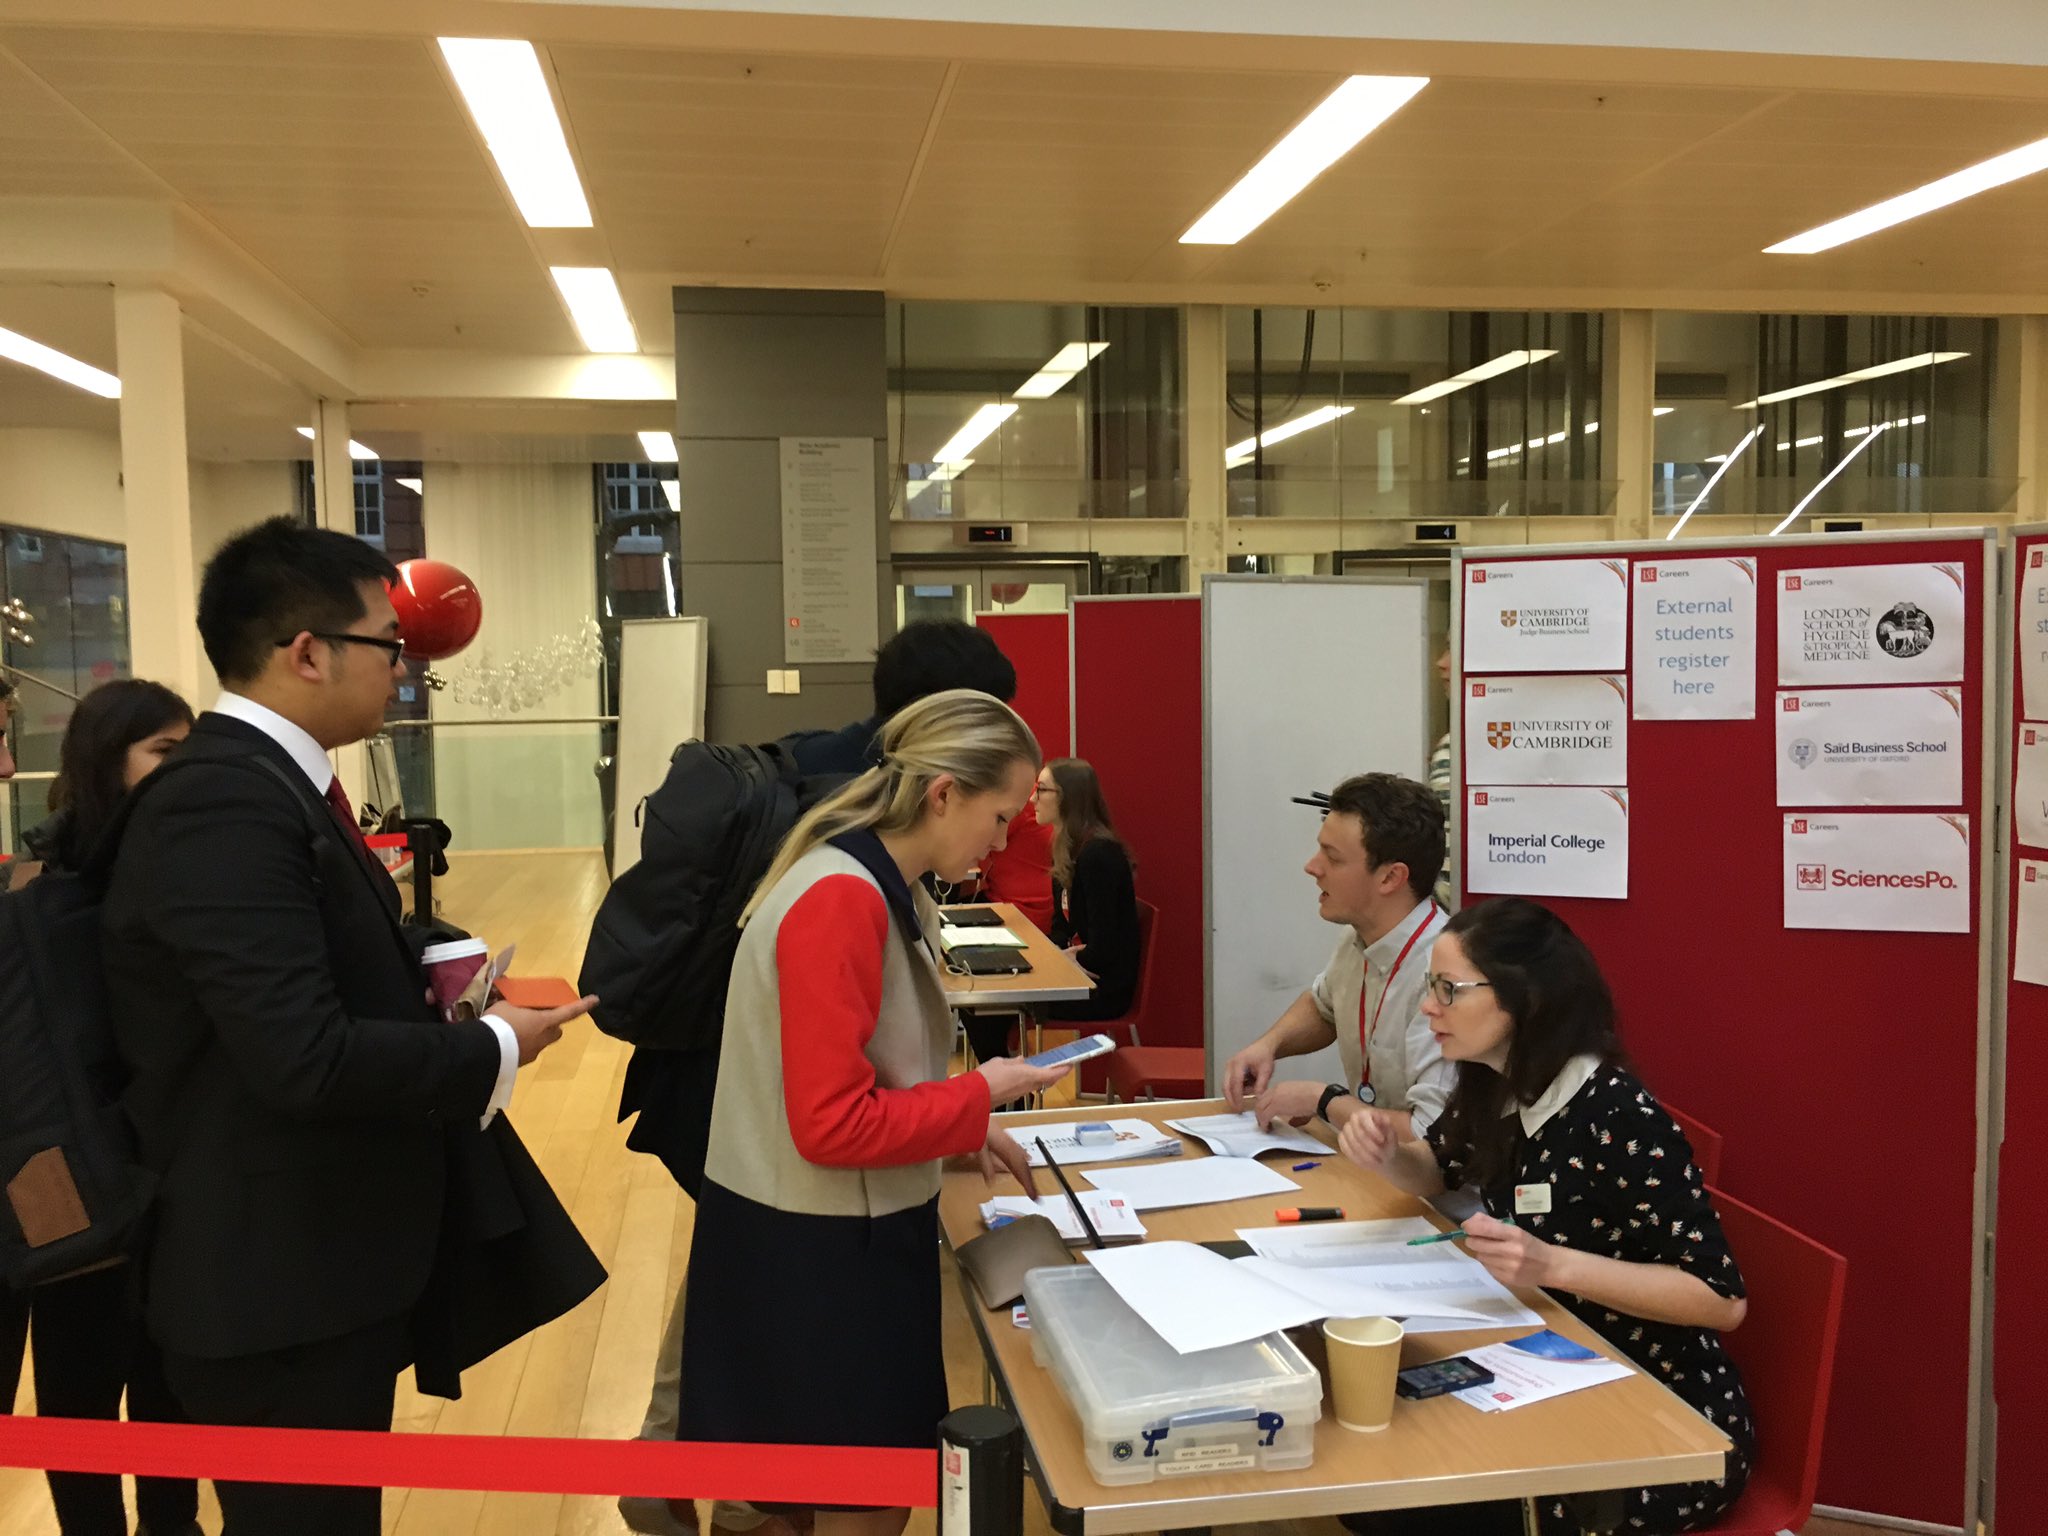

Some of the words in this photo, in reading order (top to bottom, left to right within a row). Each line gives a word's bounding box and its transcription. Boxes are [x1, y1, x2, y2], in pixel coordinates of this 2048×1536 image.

[1443, 526, 1450, 539] 4
[1473, 571, 1486, 583] LSE
[1487, 571, 1514, 580] Careers
[1642, 567, 1656, 582] LSE
[1659, 570, 1690, 579] Careers
[1786, 576, 1800, 590] LSE
[1803, 578, 1833, 587] Careers
[1656, 596, 1734, 615] External
[1519, 607, 1575, 618] UNIVERSITY
[1576, 607, 1590, 616] OF
[1803, 607, 1871, 620] LONDON
[1519, 616, 1590, 628] CAMBRIDGE
[1803, 619, 1858, 630] SCHOOL
[1858, 619, 1869, 629] of
[1519, 628, 1538, 637] Judge
[1538, 628, 1567, 636] Business
[1567, 627, 1590, 635] School
[1655, 625, 1735, 641] students
[1803, 629, 1871, 642] HYGIENE
[1658, 652, 1731, 672] register
[1803, 650, 1871, 662] MEDICINE
[1473, 684, 1486, 697] LSE
[1487, 686, 1513, 694] Careers
[1673, 679, 1715, 695] here
[1784, 697, 1798, 711] LSE
[1801, 700, 1831, 708] Careers
[1512, 720, 1592, 732] UNIVERSITY
[1595, 719, 1614, 731] OF
[1512, 736, 1614, 750] CAMBRIDGE
[1823, 741, 1850, 754] Saïd
[1852, 741, 1904, 754] Business
[1906, 740, 1947, 753] School
[1823, 755, 1866, 764] UNIVERSITY
[1869, 755, 1879, 763] OF
[1879, 754, 1910, 763] OXFORD
[1475, 793, 1488, 805] LSE
[1489, 795, 1516, 803] Careers
[1792, 820, 1806, 833] LSE
[1809, 823, 1839, 832] Careers
[1488, 833, 1547, 850] Imperial
[1550, 834, 1606, 853] College
[1488, 849, 1547, 865] London
[1831, 868, 1958, 890] SciencesPo.
